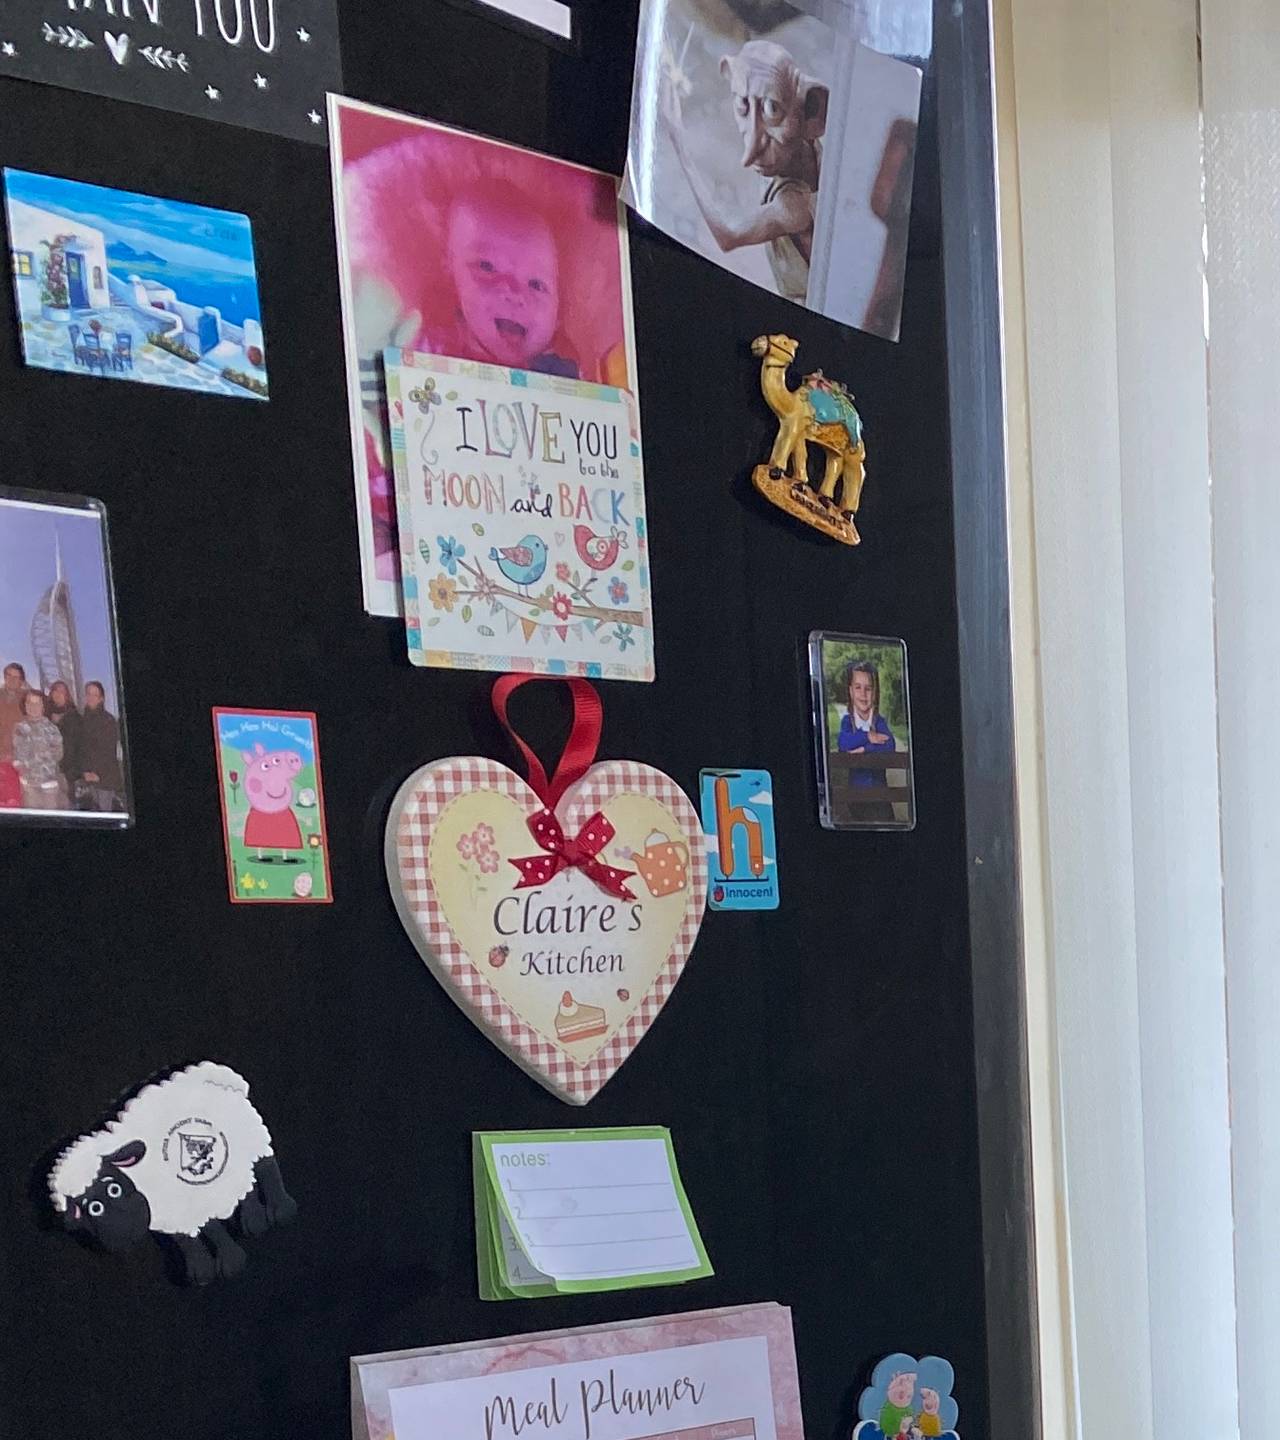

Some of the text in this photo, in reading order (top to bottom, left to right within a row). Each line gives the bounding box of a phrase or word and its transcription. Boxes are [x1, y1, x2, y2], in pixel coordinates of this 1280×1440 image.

[456, 398, 618, 464] I LOVE YOU
[579, 457, 597, 476] to
[422, 464, 630, 526] MOON and BACK
[493, 890, 643, 936] Claire's
[519, 949, 624, 977] Kitchen
[500, 1152, 549, 1167] notes:
[483, 1368, 706, 1440] Meal Planner
